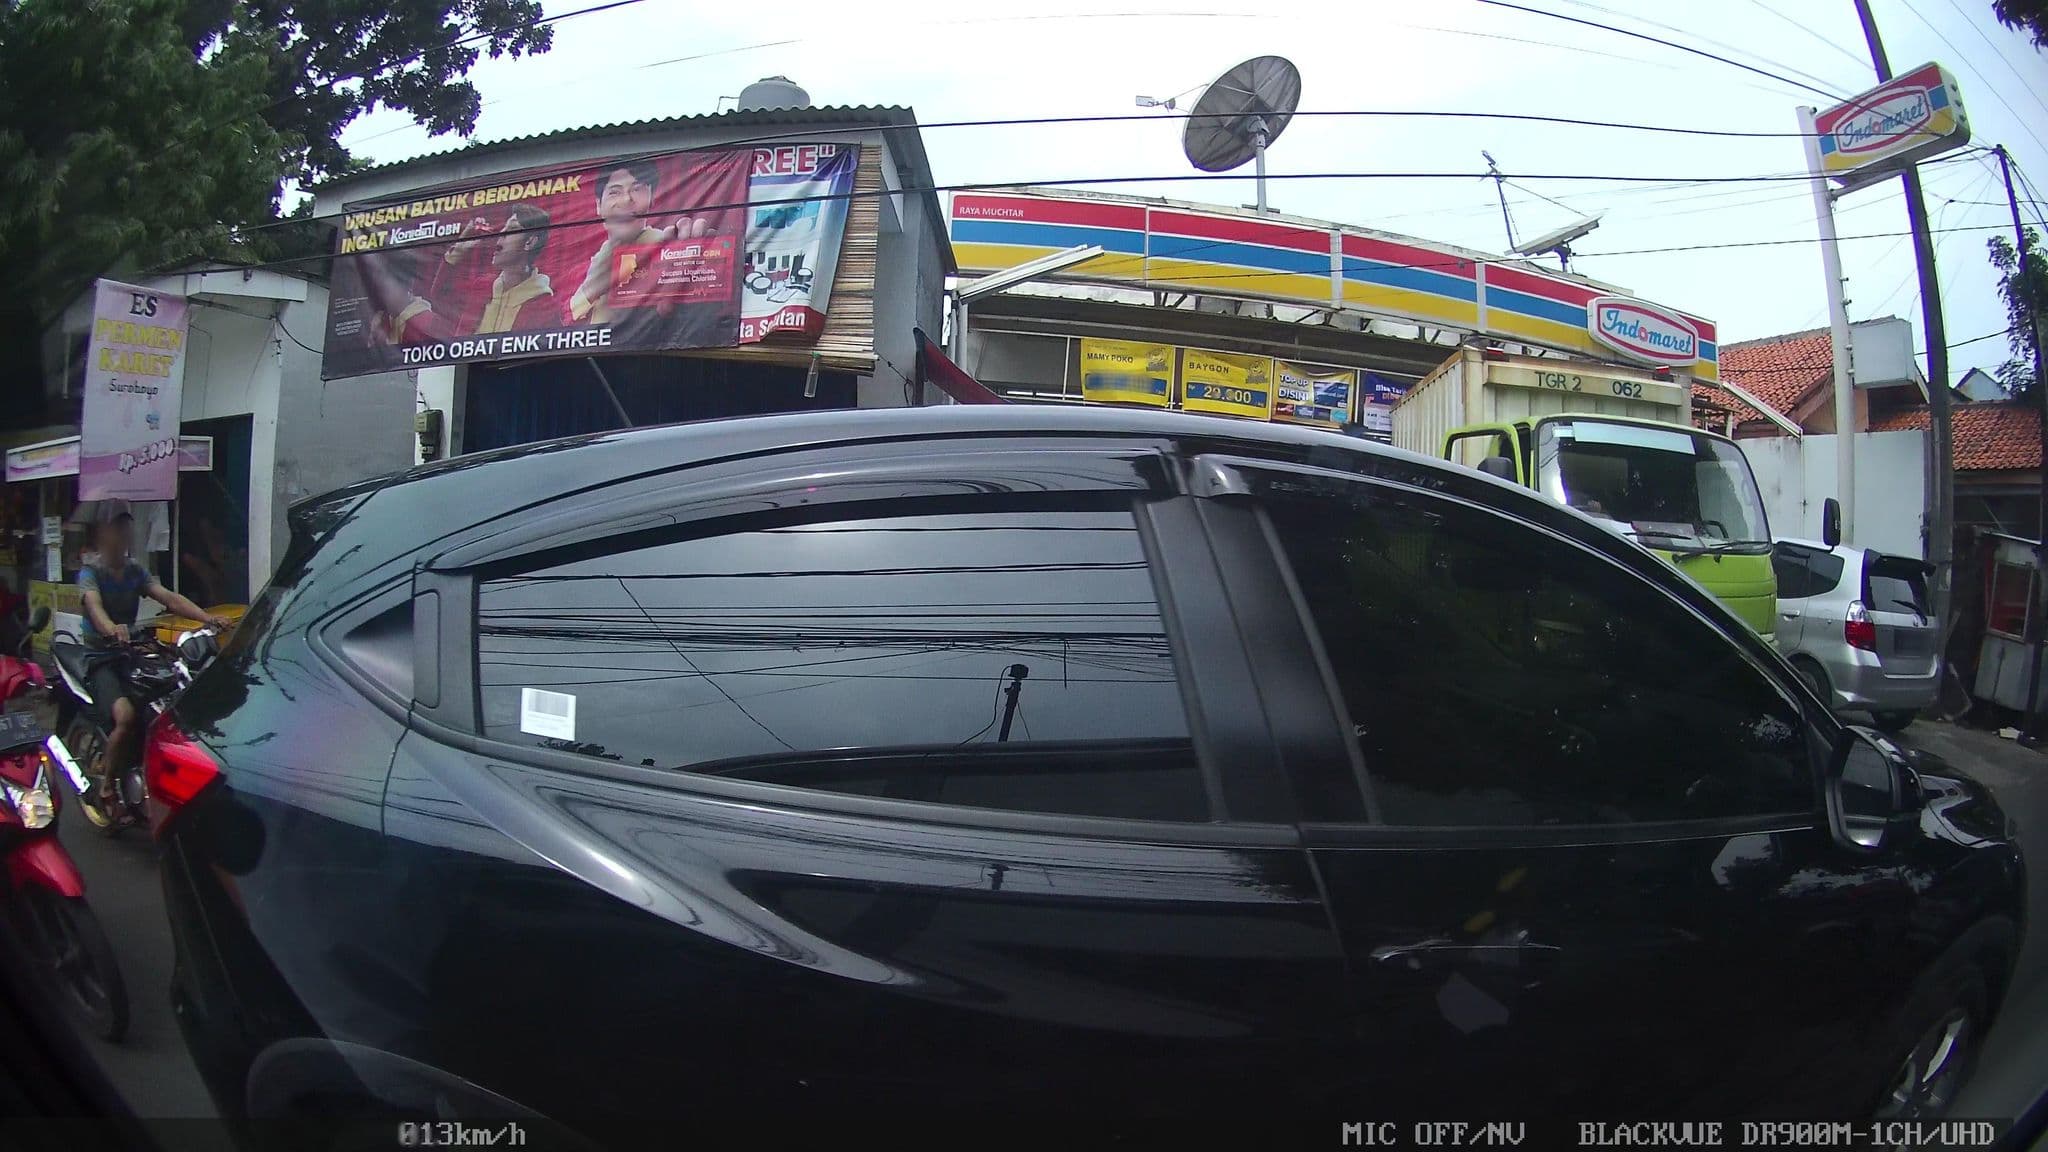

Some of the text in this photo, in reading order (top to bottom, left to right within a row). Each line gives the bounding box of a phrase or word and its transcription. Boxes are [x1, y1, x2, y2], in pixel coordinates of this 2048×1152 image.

[1842, 95, 1924, 147] Indomaret
[345, 175, 582, 231] URUSAN BATUK BERDAHAK
[959, 205, 1024, 218] RAYA MUCHTAR
[341, 230, 389, 254] INGAT
[436, 222, 461, 237] OBH
[129, 293, 158, 317] ES
[1602, 308, 1693, 355] Indomaret
[402, 327, 612, 364] TOKO OBAT ENK THREE
[1087, 352, 1134, 364] MAMY POKO
[1188, 362, 1230, 374] BAYGON
[1280, 373, 1309, 387] TOP UP
[1278, 387, 1309, 401] DISINI
[1535, 371, 1642, 399] TGR 2 062
